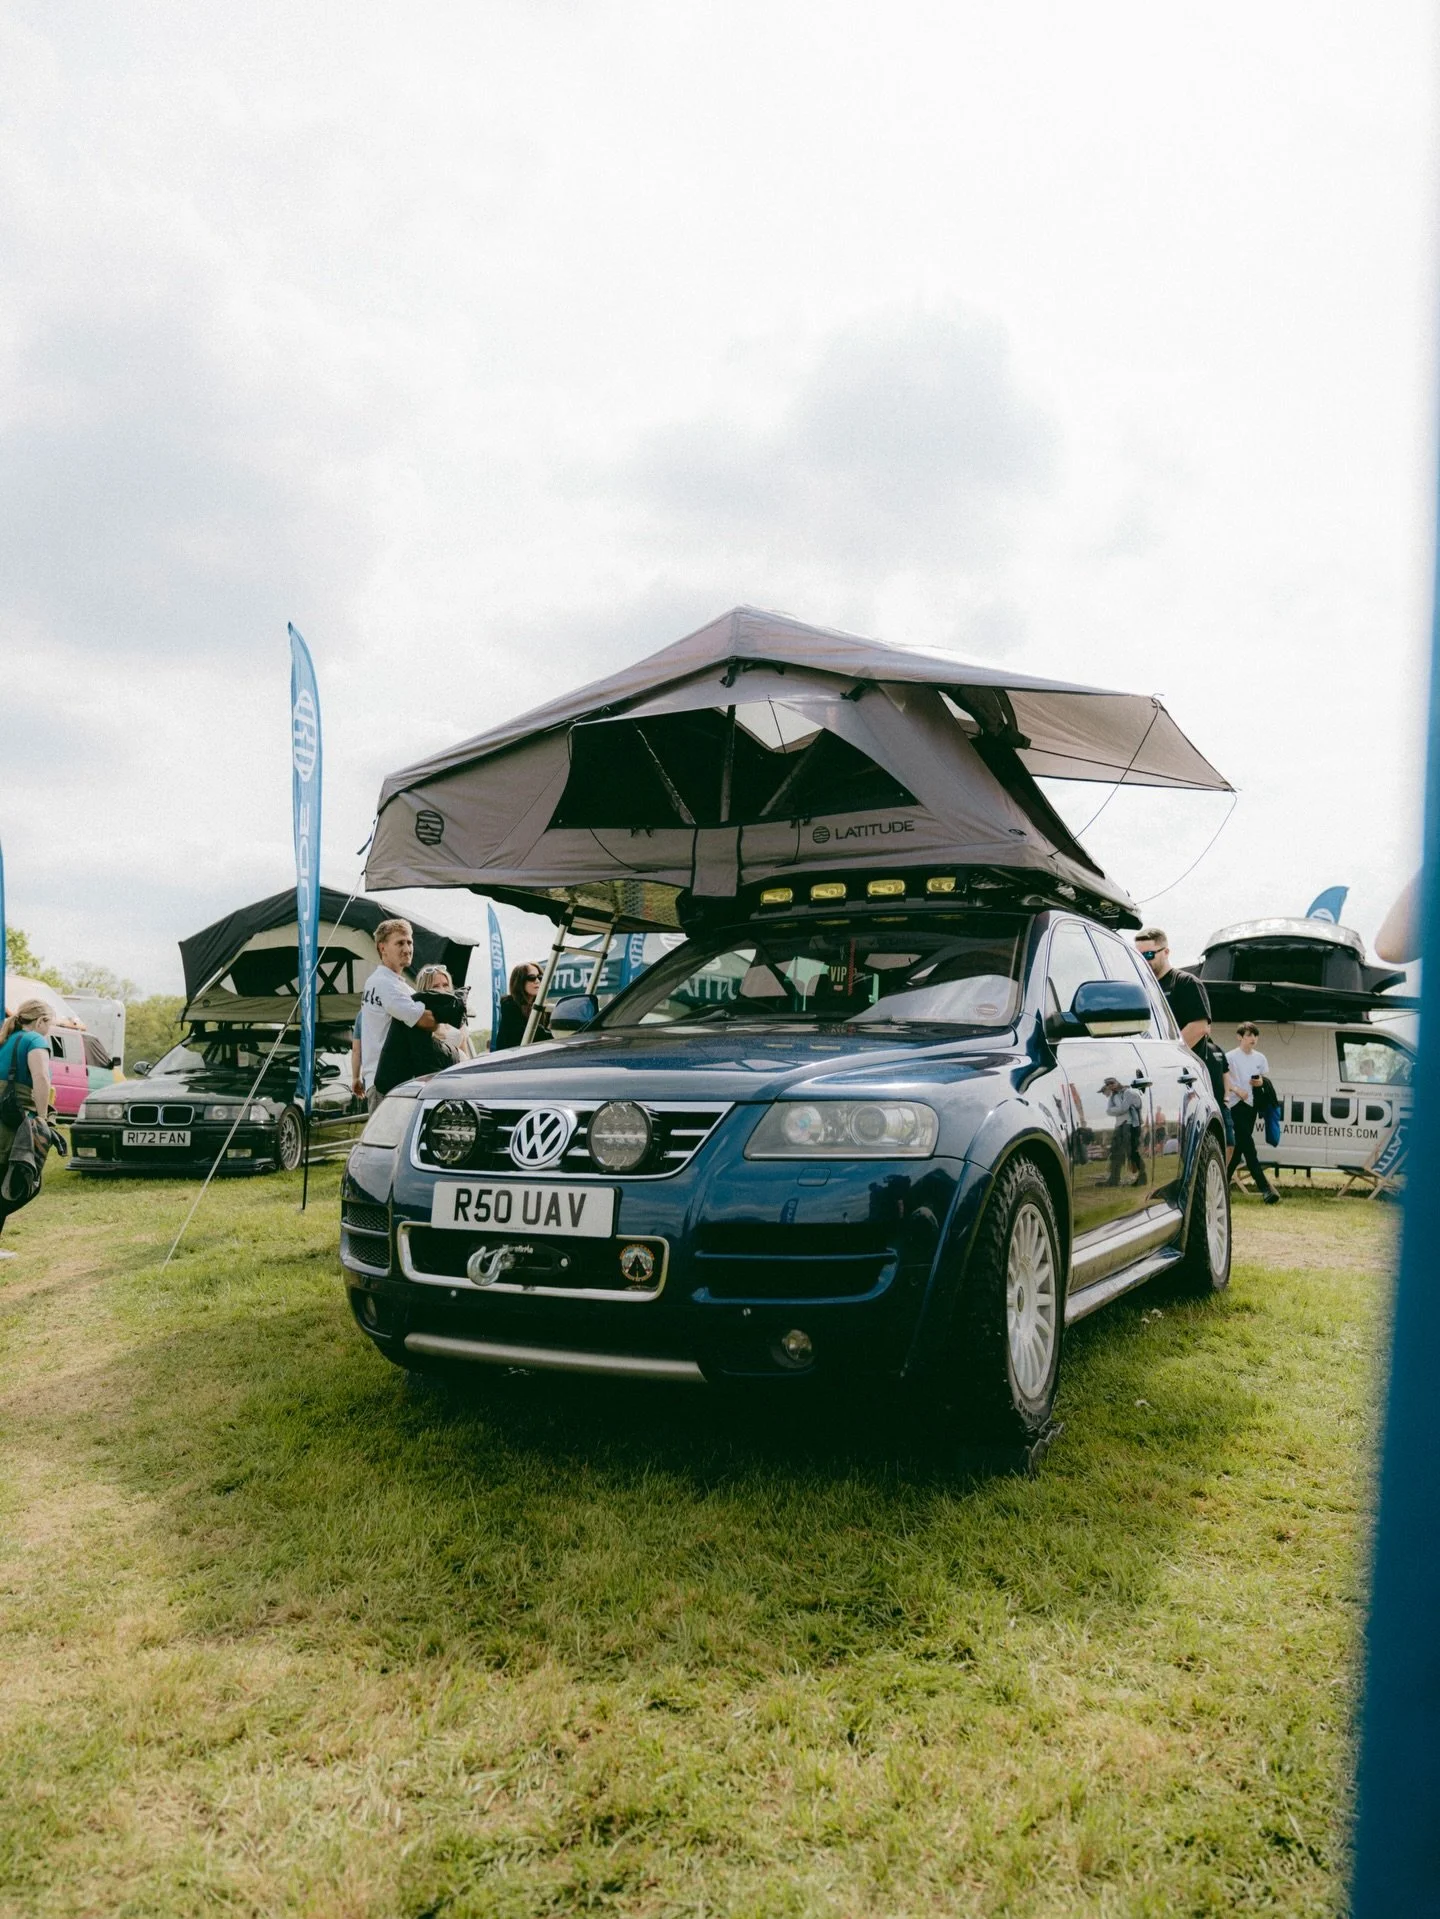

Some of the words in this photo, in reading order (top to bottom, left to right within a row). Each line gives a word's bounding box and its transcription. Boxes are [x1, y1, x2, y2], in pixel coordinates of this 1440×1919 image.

[835, 820, 915, 840] LATITUDE
[549, 968, 609, 991] ITUDE
[830, 966, 848, 982] VIP
[127, 1132, 156, 1143] R172
[159, 1132, 186, 1143] FAN
[453, 1188, 512, 1224] R50
[522, 1190, 587, 1228] UAV
